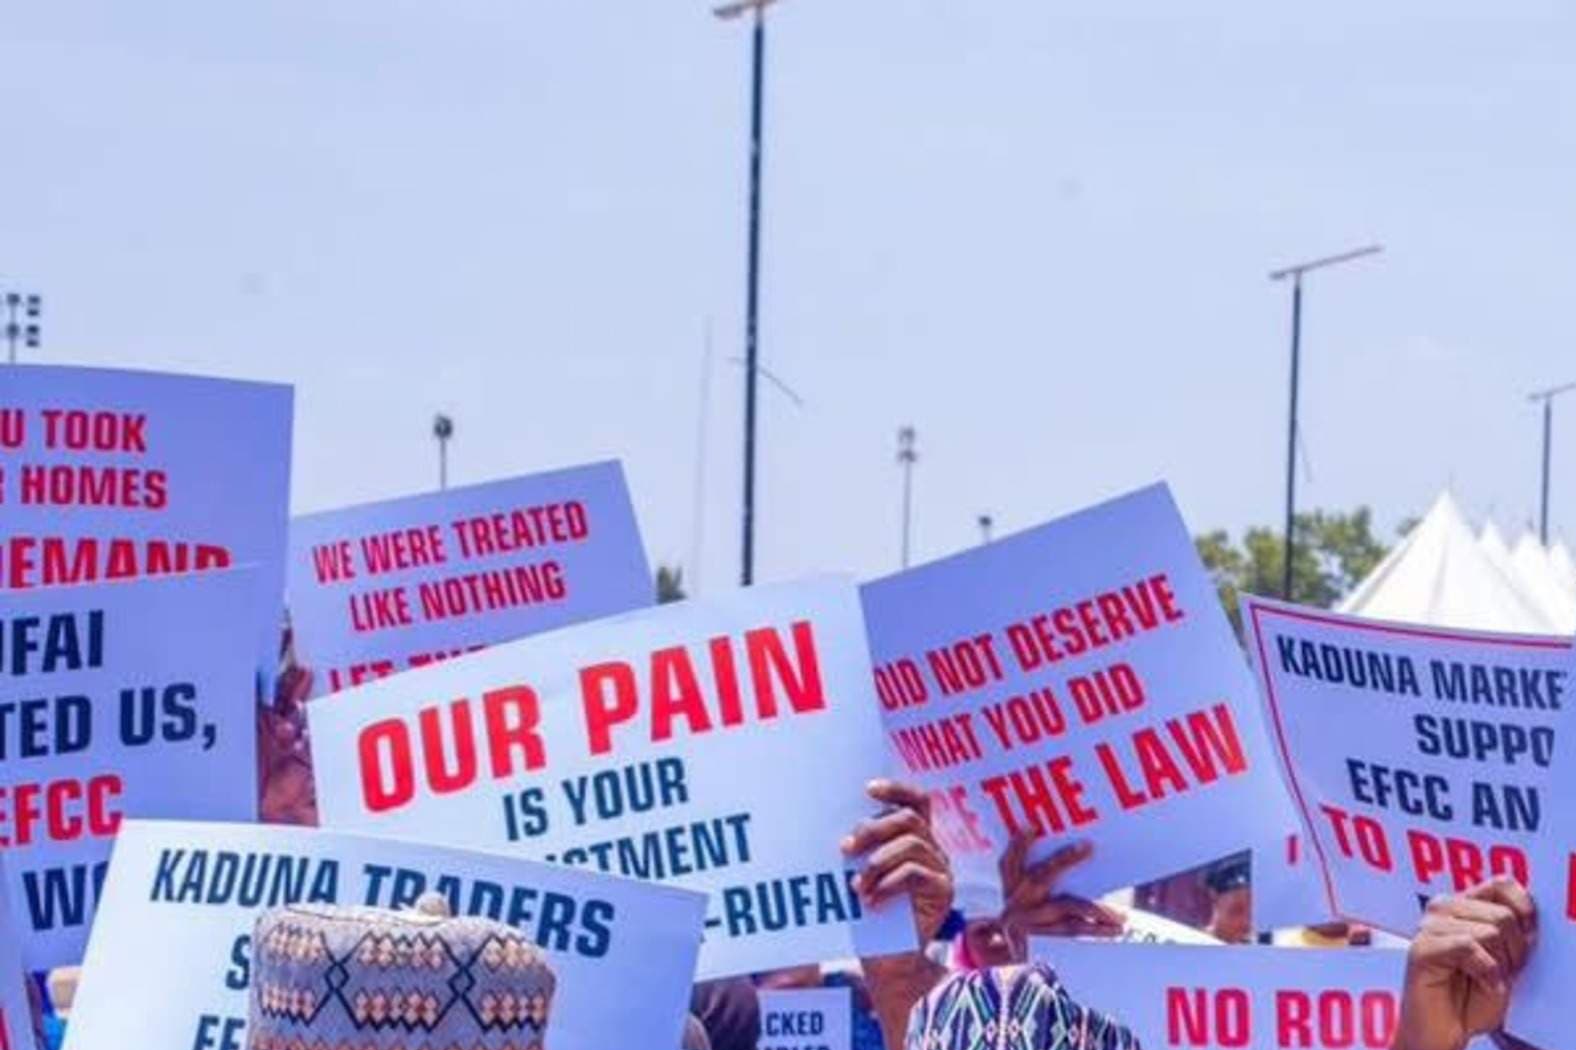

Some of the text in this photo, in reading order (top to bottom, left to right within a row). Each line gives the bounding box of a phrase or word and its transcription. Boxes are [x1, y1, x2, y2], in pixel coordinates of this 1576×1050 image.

[41, 409, 148, 453] TOOK
[20, 464, 168, 509] HOMES
[0, 537, 231, 589] EMAN
[312, 500, 588, 585] WE WERE TREATED
[350, 560, 566, 633] LIKE NOTHING
[0, 609, 104, 676] FAI
[873, 574, 1185, 712] DID NOT DESERVE
[1277, 634, 1568, 711] KADUNA MARKE
[120, 682, 216, 751] US,
[358, 621, 826, 813] OUR PAIN
[890, 661, 1145, 774] WHAT YOU DID
[1413, 713, 1556, 769] SUPPO
[503, 757, 690, 842] IS YOUR
[981, 754, 1099, 842] THE
[1095, 703, 1249, 811] LAW
[1346, 758, 1542, 832] EFCC AN
[0, 774, 124, 847] FCC
[1319, 802, 1393, 873] TO
[150, 848, 338, 907] KADUNA
[545, 812, 752, 881] TMENT
[699, 869, 862, 940] -RUFAI
[1166, 986, 1253, 1048] NO
